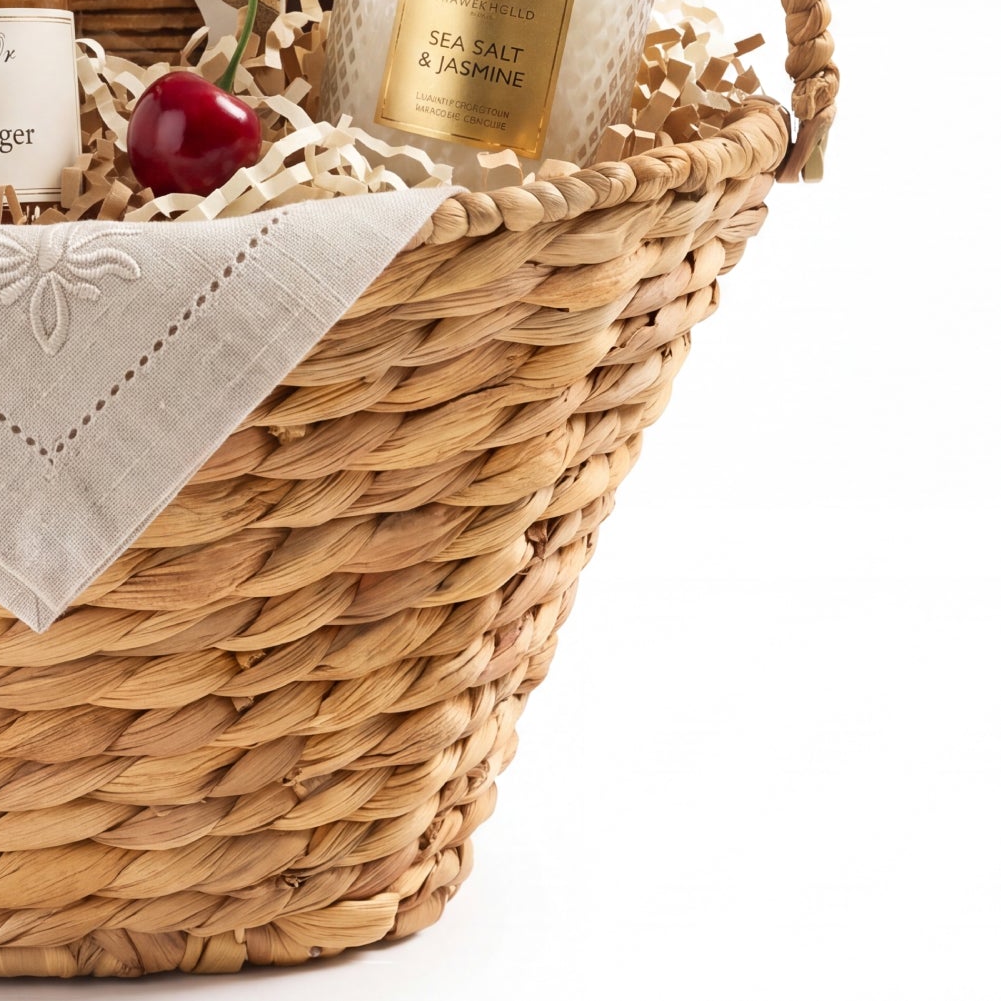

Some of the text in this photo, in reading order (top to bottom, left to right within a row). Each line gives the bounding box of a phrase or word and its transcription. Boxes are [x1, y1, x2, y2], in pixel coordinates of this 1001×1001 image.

[428, 30, 525, 64] SEA SALT
[418, 51, 526, 88] & JASMINE
